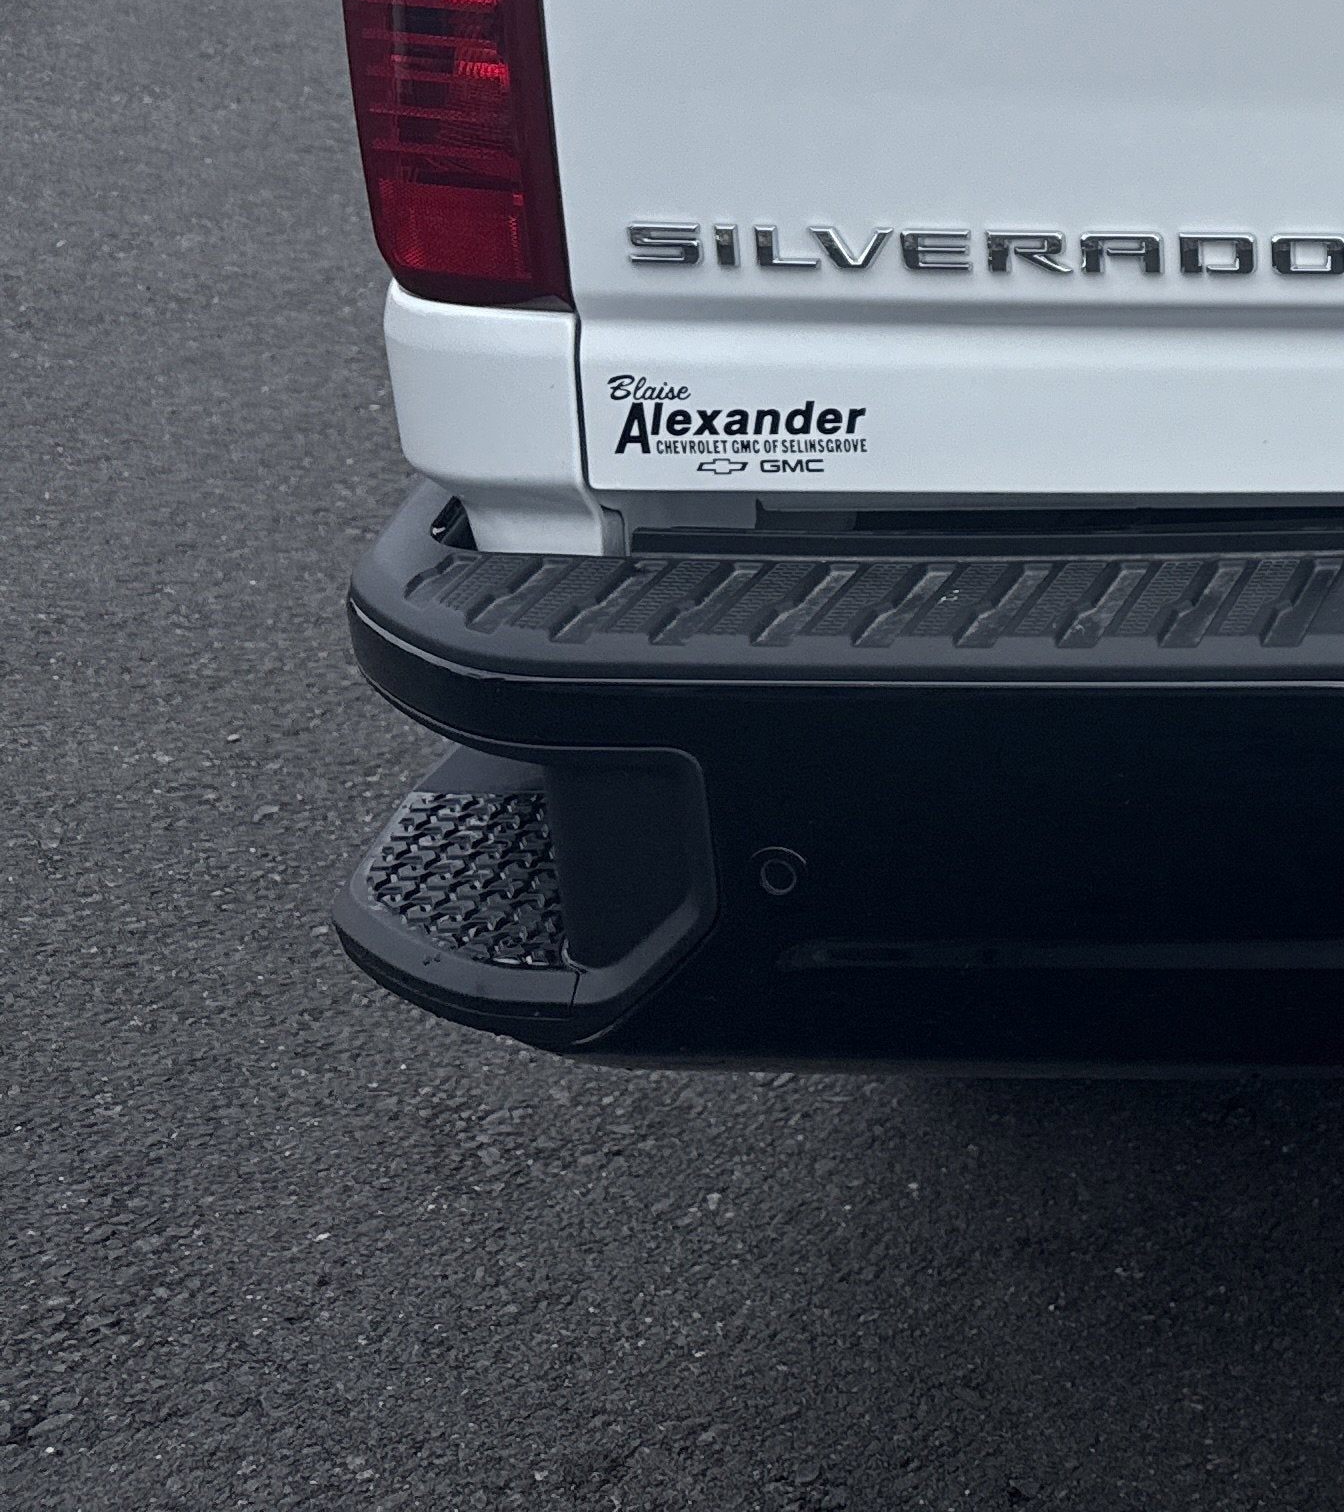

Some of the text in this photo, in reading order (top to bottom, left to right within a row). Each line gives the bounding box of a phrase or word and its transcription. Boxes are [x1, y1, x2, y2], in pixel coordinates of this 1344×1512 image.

[607, 374, 691, 401] Blaise
[615, 400, 866, 454] Alexander
[656, 438, 868, 454] CHEVROLET GMC OF SELINSGROVE
[759, 458, 825, 473] GMC
